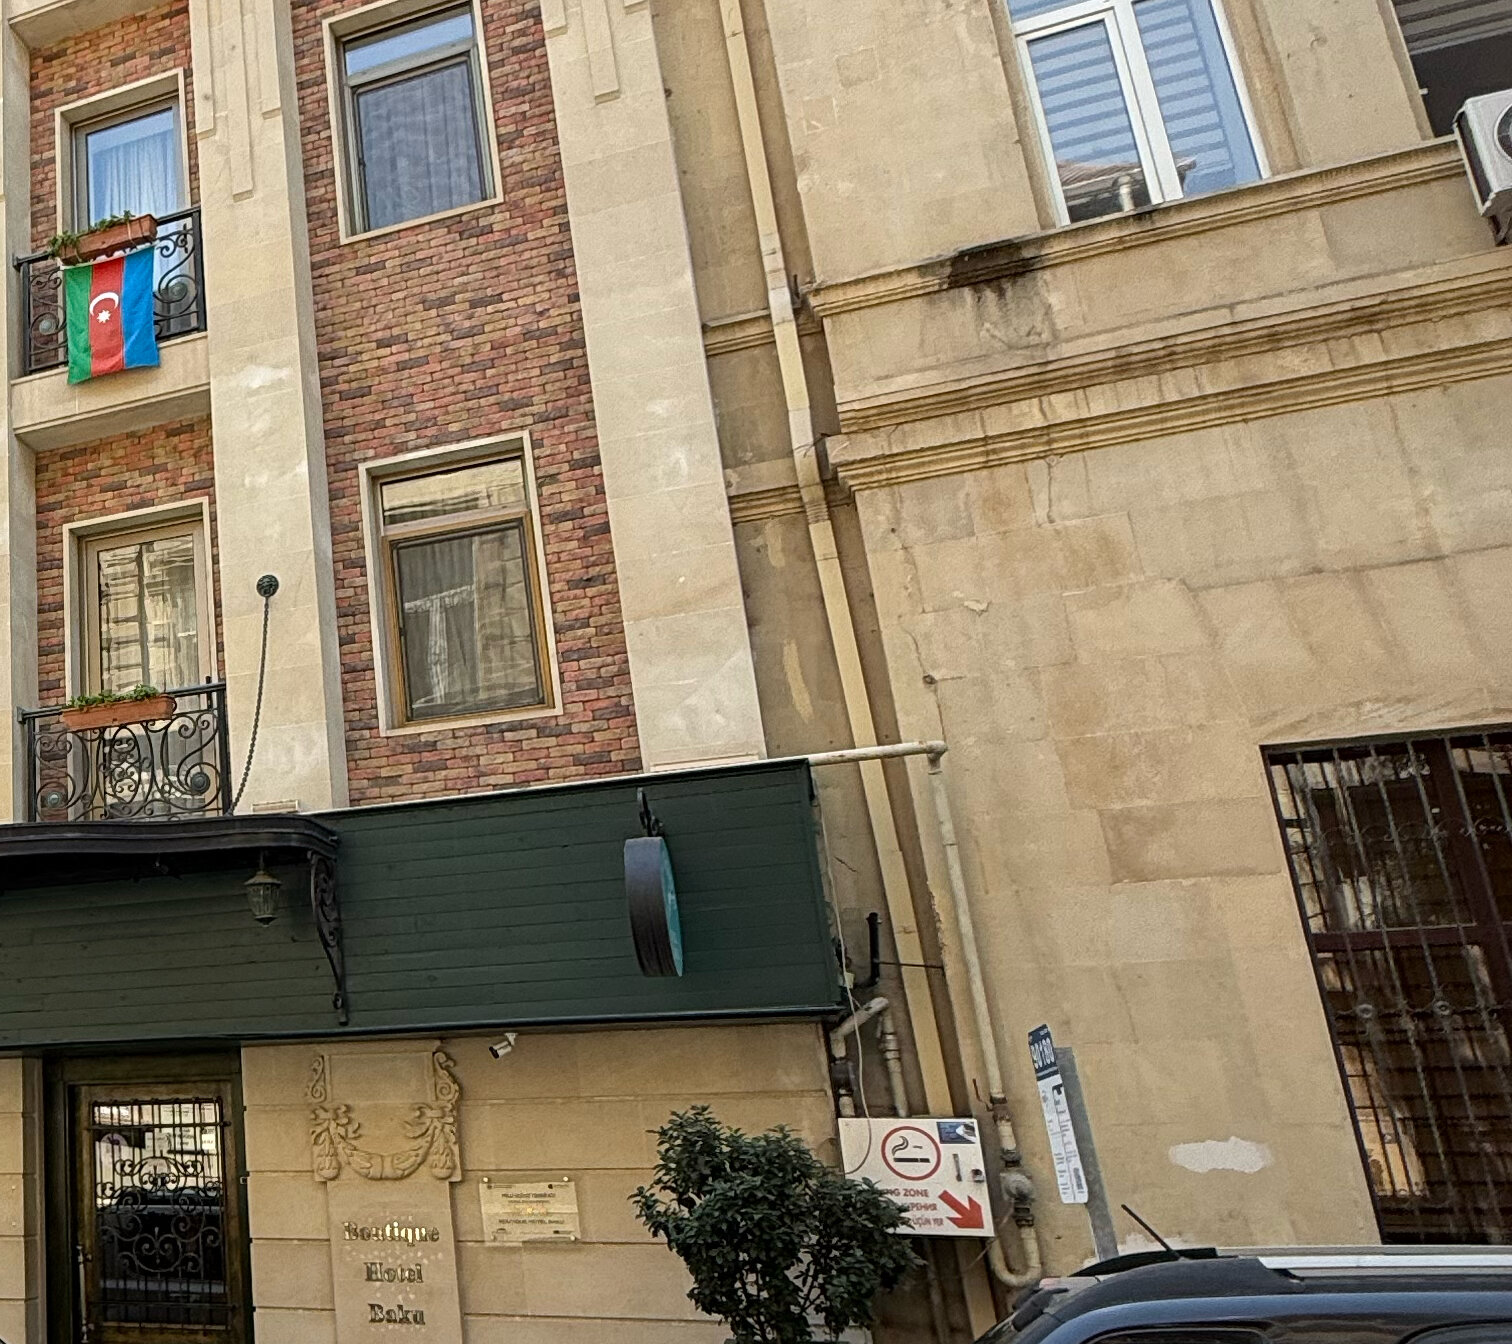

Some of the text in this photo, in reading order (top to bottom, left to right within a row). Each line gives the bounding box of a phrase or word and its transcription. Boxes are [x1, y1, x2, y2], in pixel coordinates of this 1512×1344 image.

[902, 1188, 929, 1198] ZONE
[908, 1202, 938, 1212] РЕНИЯ
[342, 1221, 440, 1247] Boutique
[363, 1261, 424, 1284] Hotel
[368, 1303, 426, 1325] Baku
